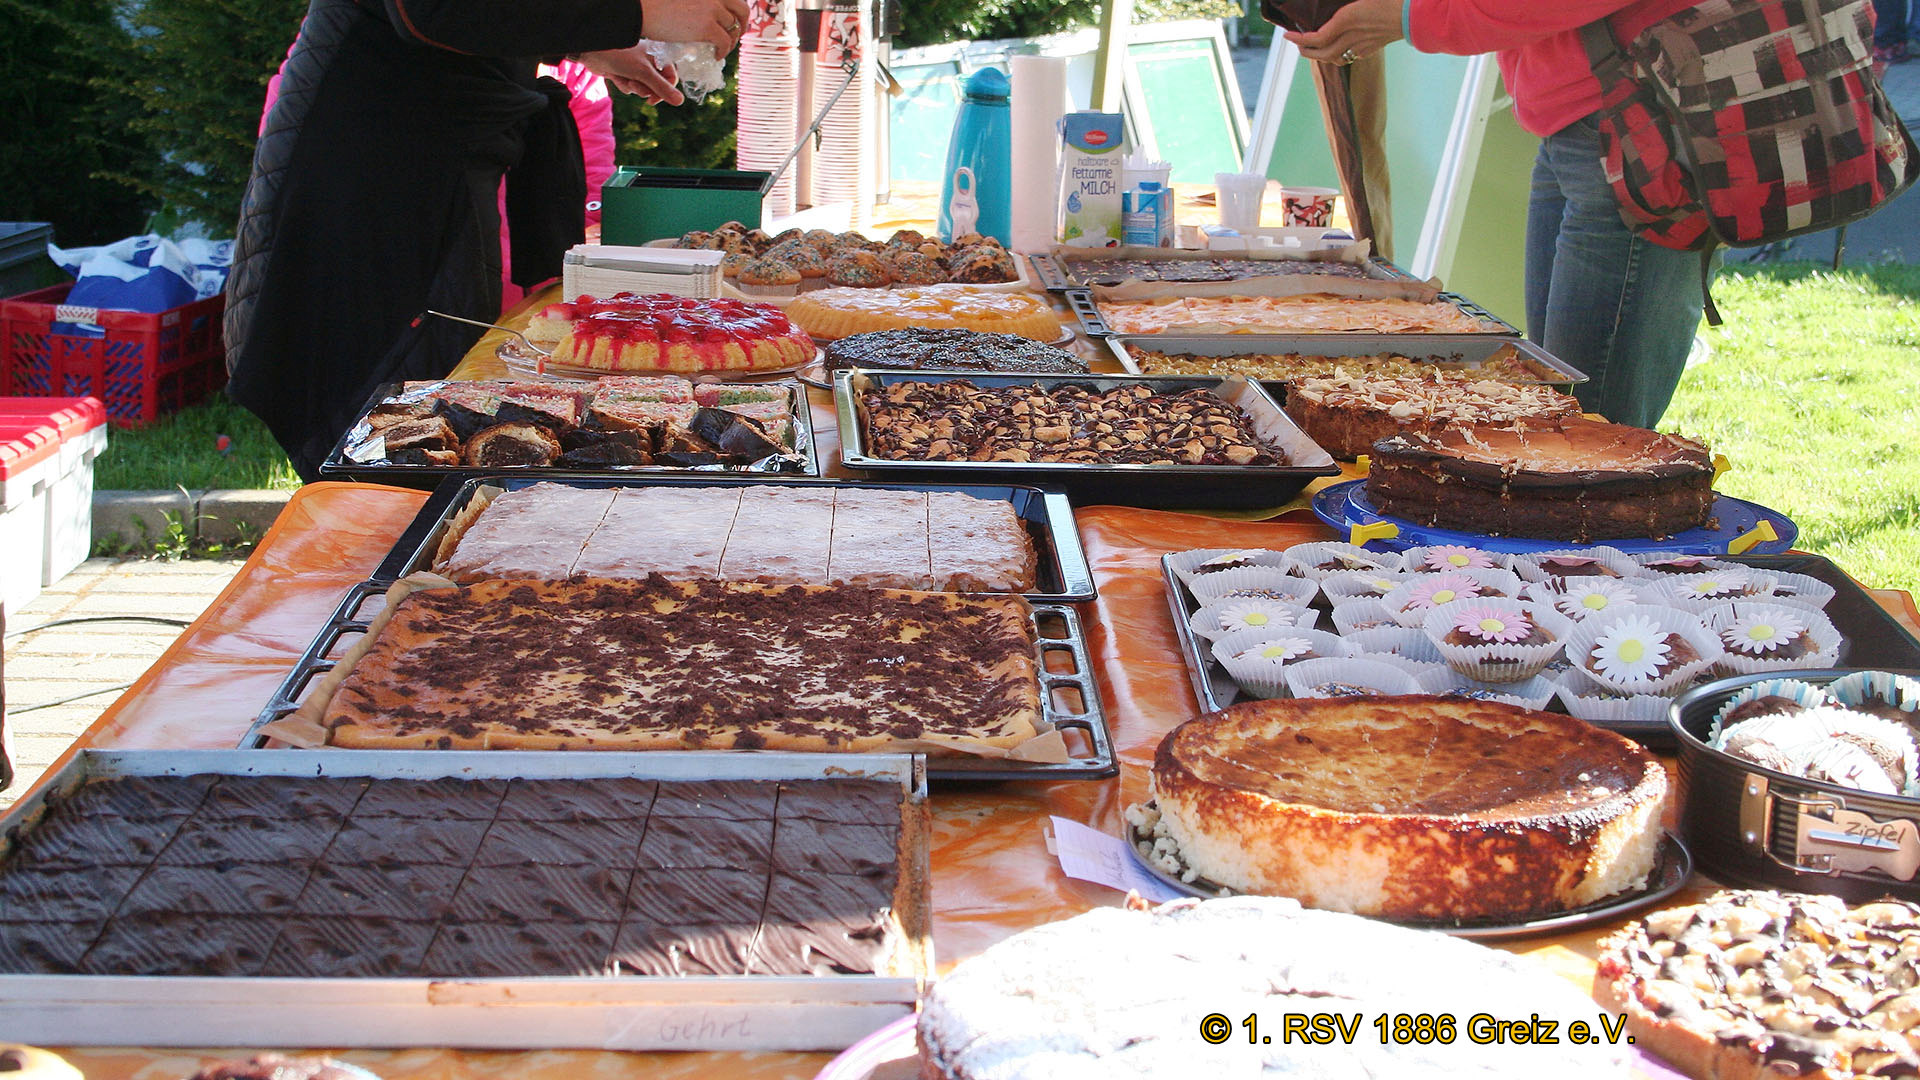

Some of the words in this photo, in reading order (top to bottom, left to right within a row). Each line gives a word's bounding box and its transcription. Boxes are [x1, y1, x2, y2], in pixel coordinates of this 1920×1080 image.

[1072, 167, 1112, 179] fettarme
[1081, 181, 1116, 194] MILCH
[1845, 821, 1906, 846] Zipfel
[660, 1013, 751, 1042] Gehrt
